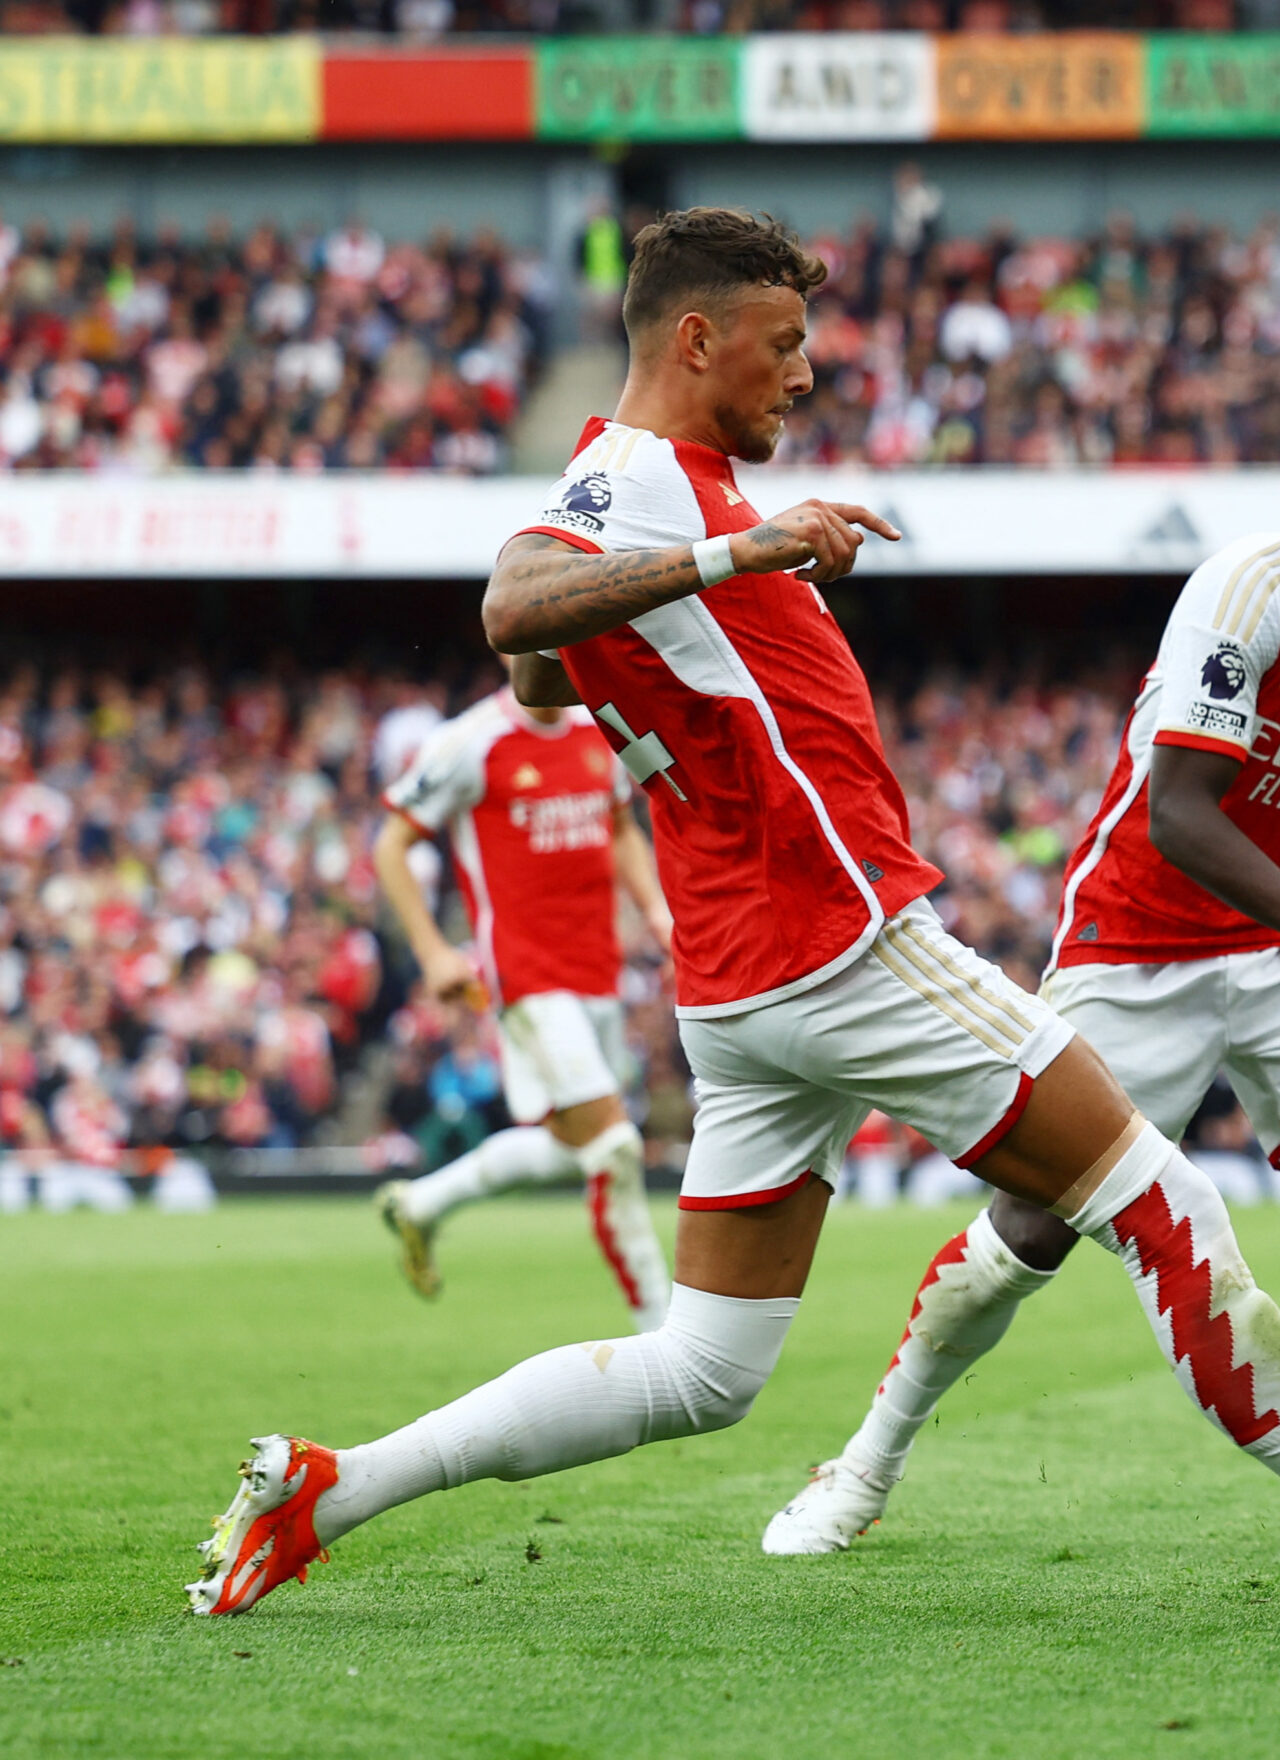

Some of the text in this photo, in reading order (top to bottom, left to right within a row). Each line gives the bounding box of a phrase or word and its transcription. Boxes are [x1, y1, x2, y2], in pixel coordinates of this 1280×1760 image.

[552, 54, 729, 118] OVER
[768, 56, 912, 114] AND
[941, 54, 1122, 115] OVER
[1208, 708, 1243, 729] room
